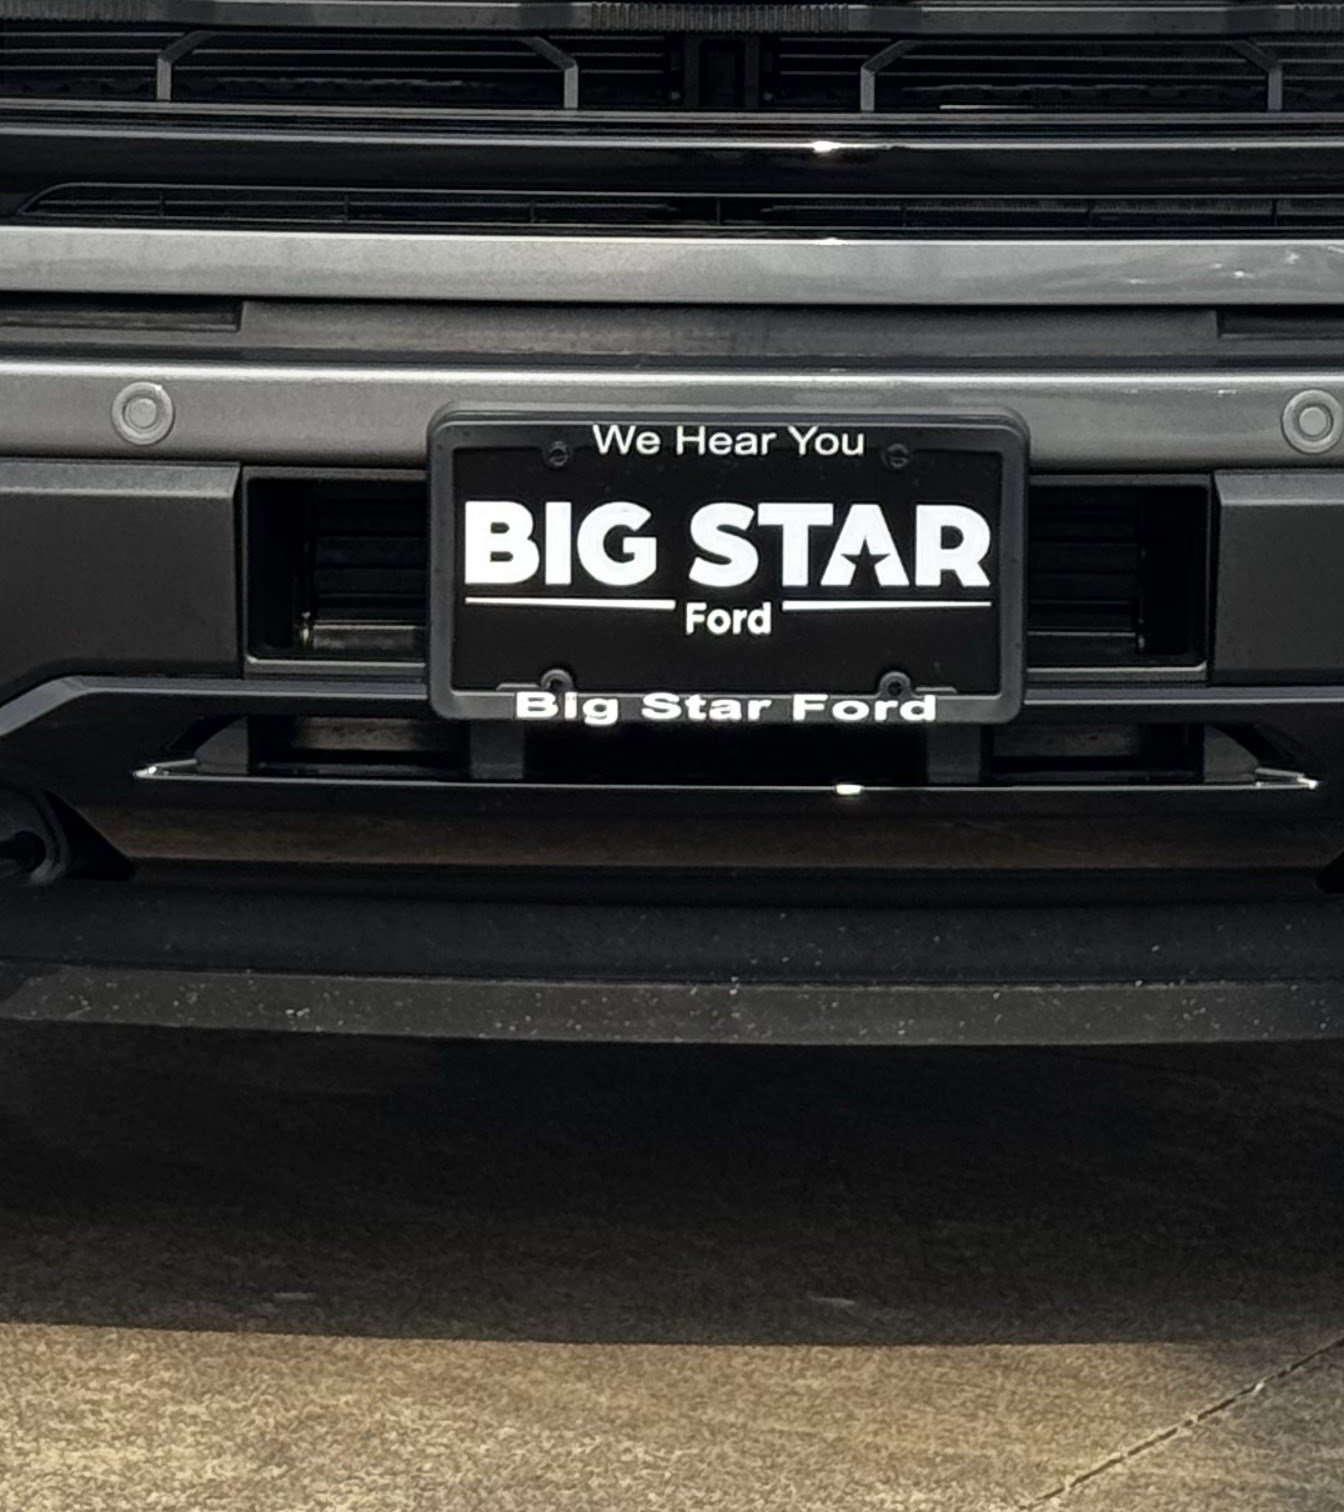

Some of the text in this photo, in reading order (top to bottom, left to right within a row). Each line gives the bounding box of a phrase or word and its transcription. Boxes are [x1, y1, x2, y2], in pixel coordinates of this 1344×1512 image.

[593, 423, 866, 457] We Hear You
[464, 500, 991, 588] BIG STAR
[685, 601, 772, 635] Ford
[515, 691, 938, 725] Big Star Ford
